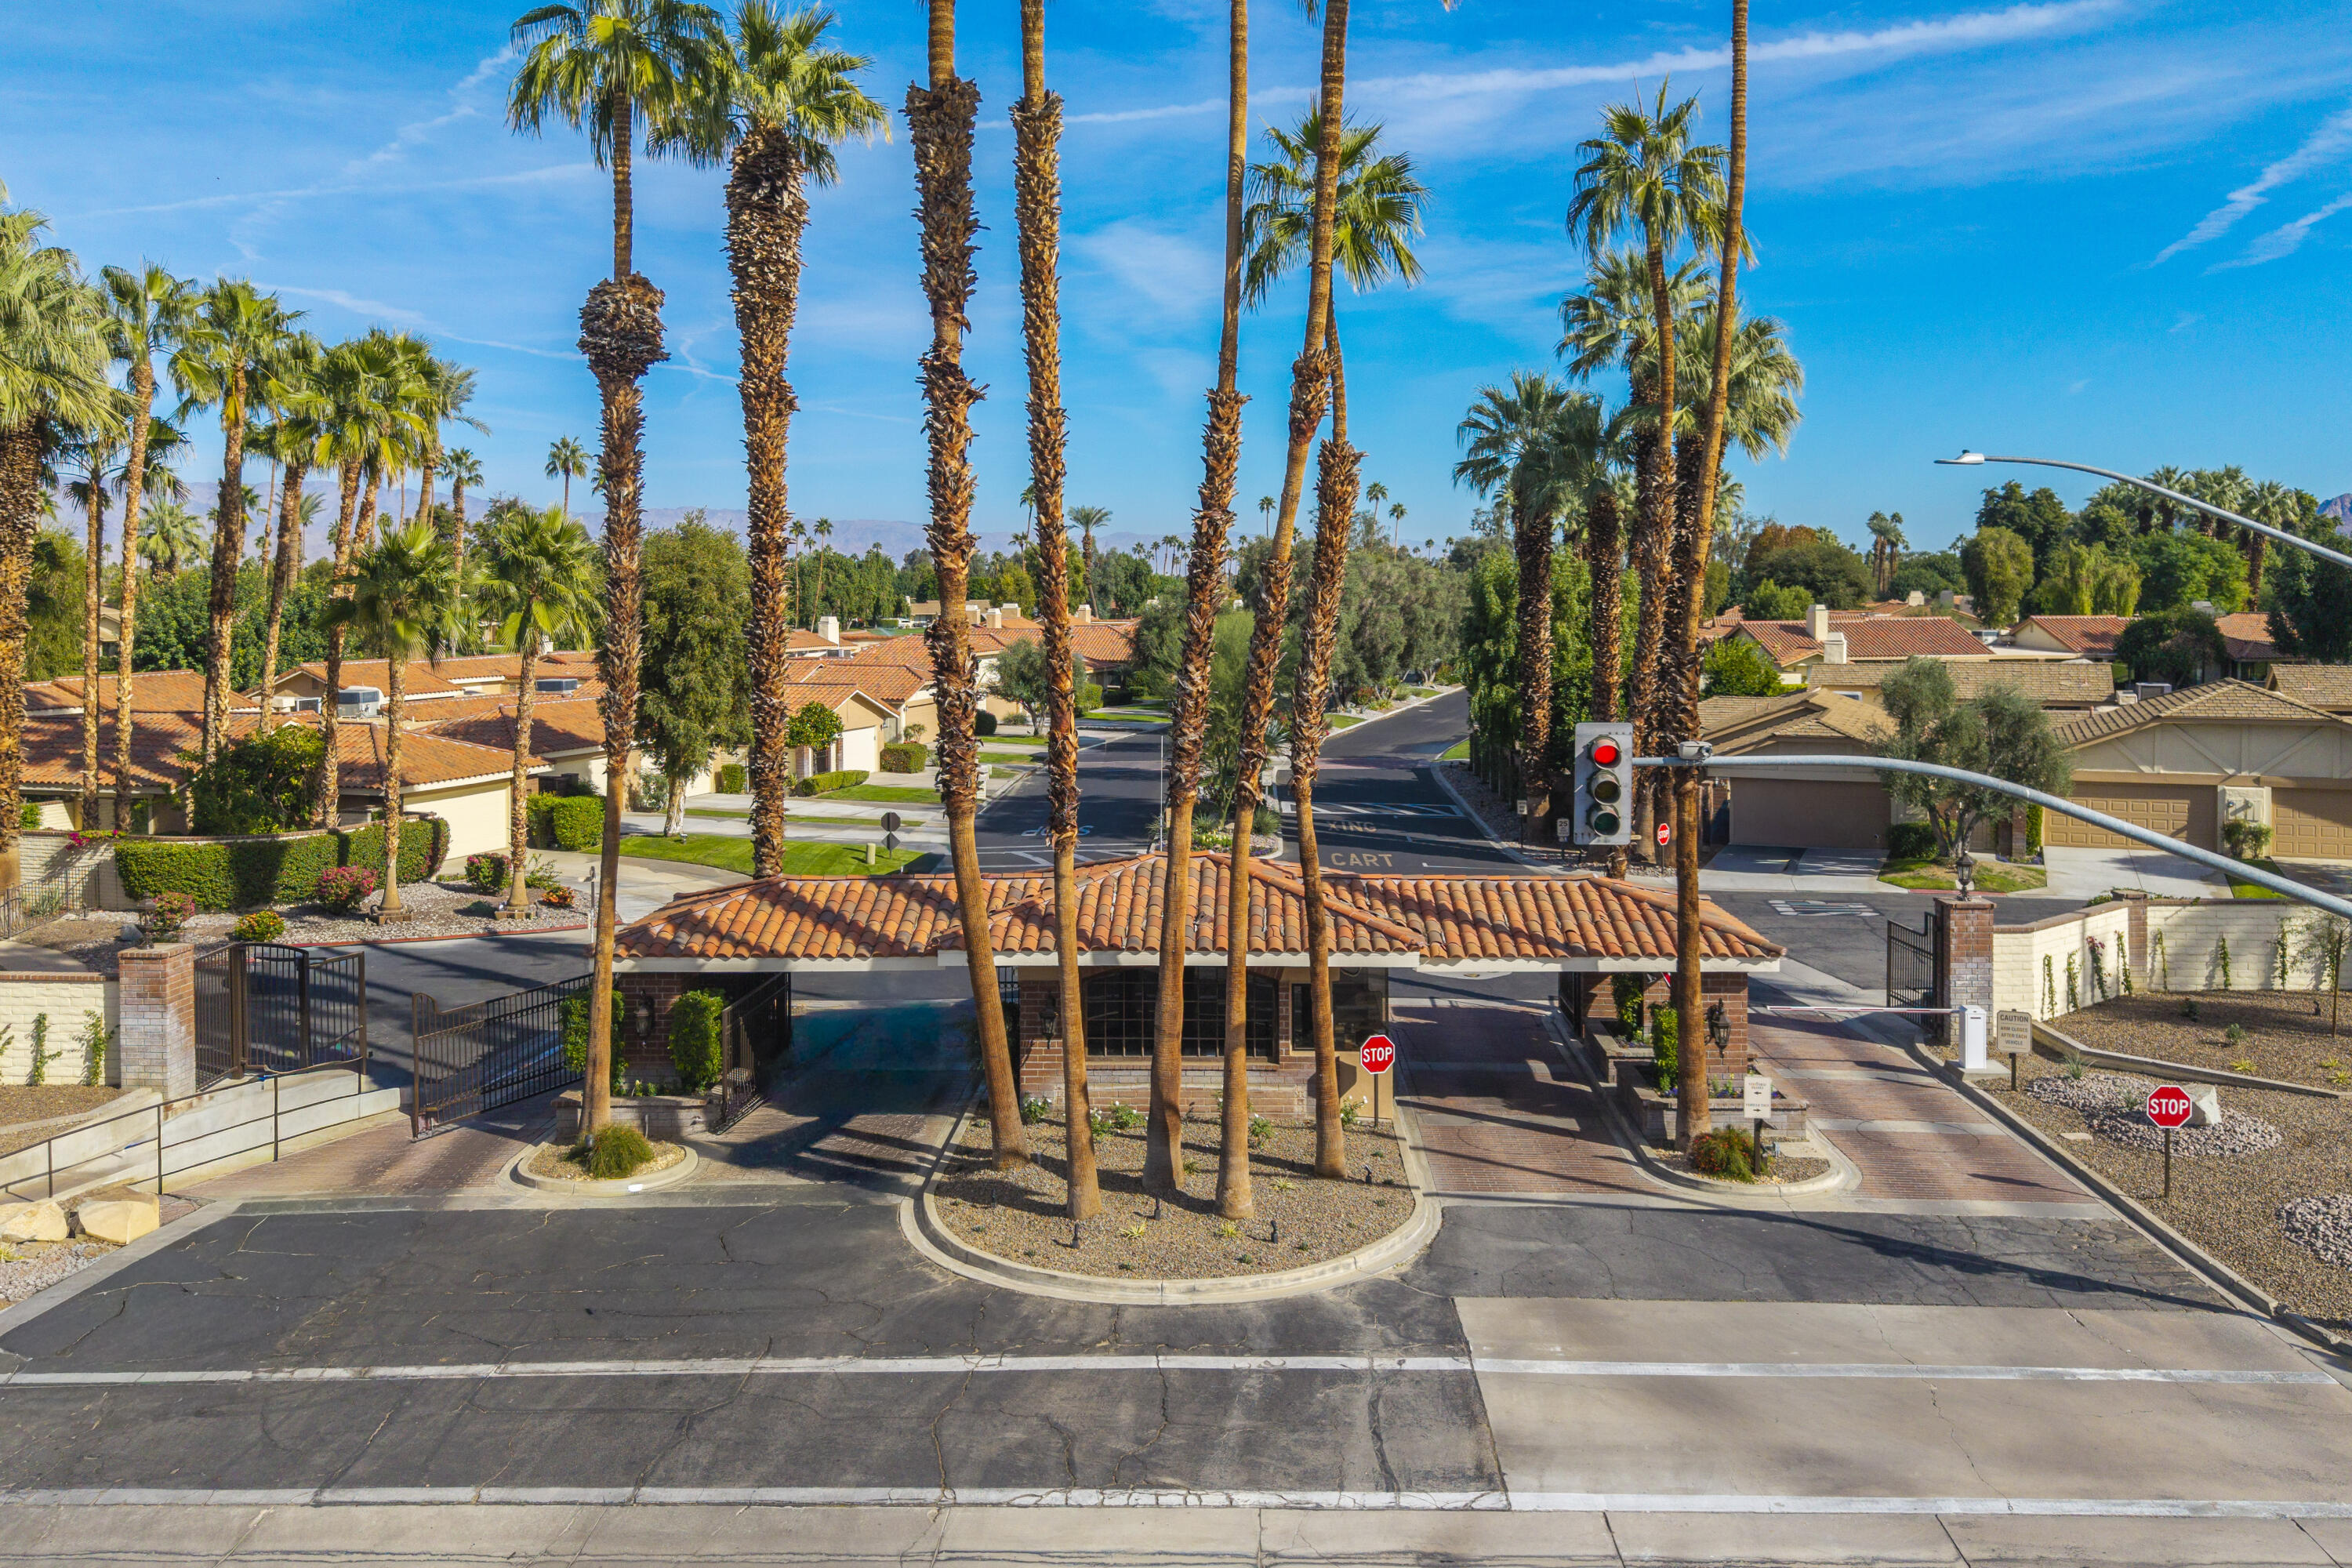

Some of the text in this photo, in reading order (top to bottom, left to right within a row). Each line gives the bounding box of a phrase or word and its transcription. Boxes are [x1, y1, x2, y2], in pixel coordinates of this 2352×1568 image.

[1327, 820, 1377, 833] XING
[1330, 852, 1393, 867] CART
[2000, 1014, 2029, 1023] CAUTION
[1363, 1047, 1392, 1062] STOP
[2150, 1098, 2189, 1115] STOP
